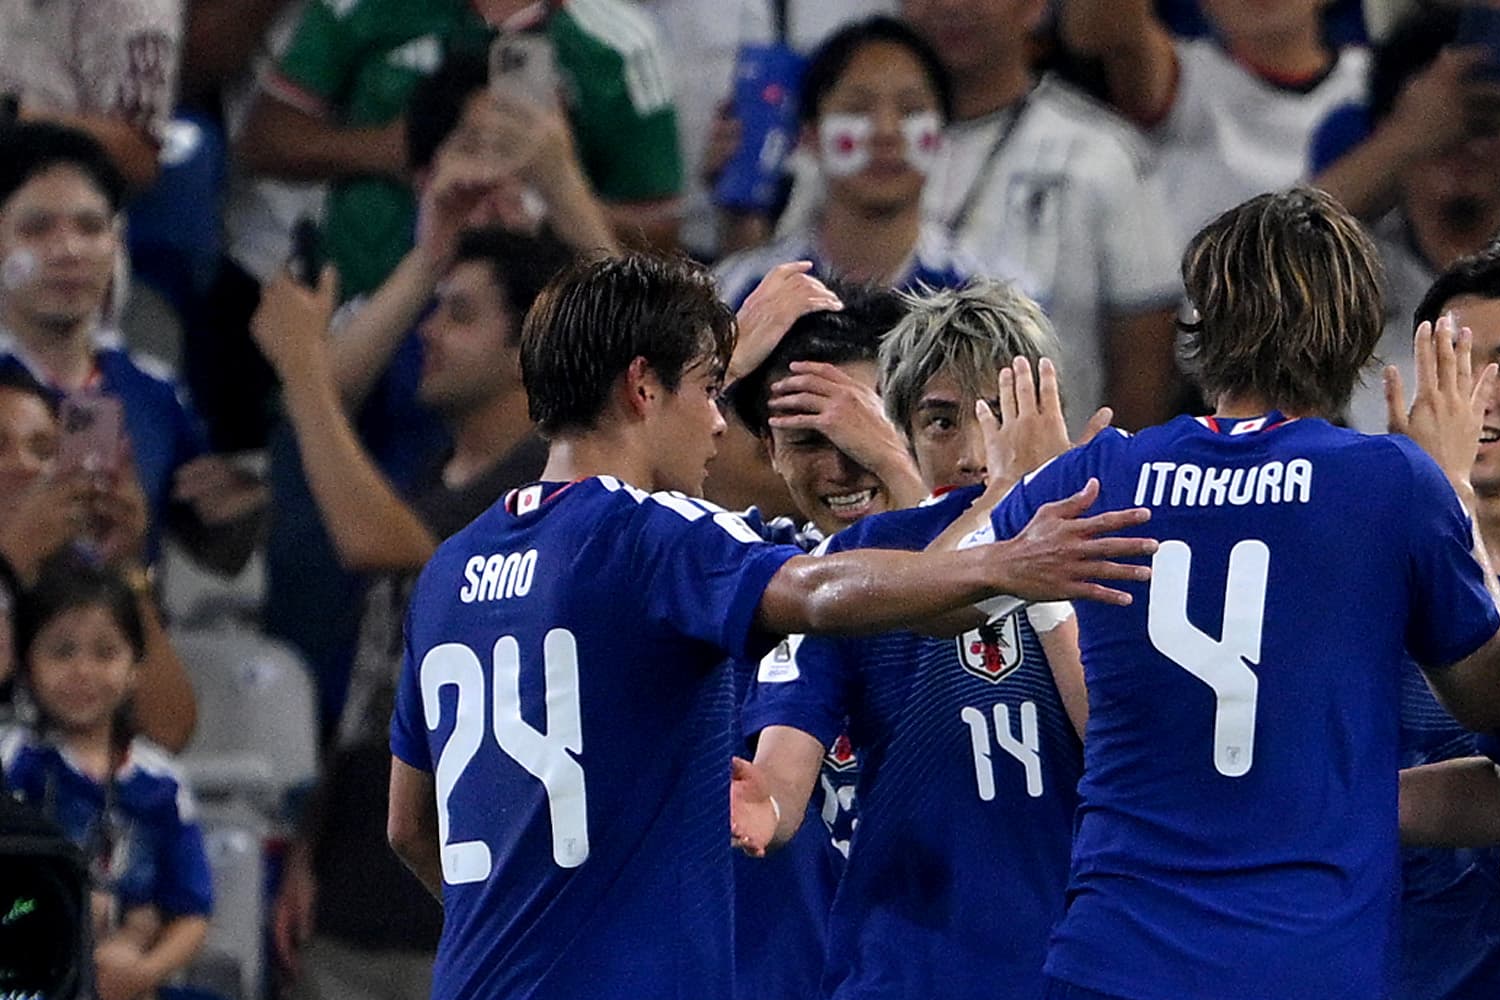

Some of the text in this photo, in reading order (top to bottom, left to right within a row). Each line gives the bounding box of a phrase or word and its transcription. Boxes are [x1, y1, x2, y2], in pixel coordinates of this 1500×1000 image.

[1135, 459, 1312, 506] ITAKURA
[461, 549, 537, 602] SANO
[1148, 539, 1269, 776] 4
[421, 628, 588, 884] 24
[962, 702, 1042, 800] 14
